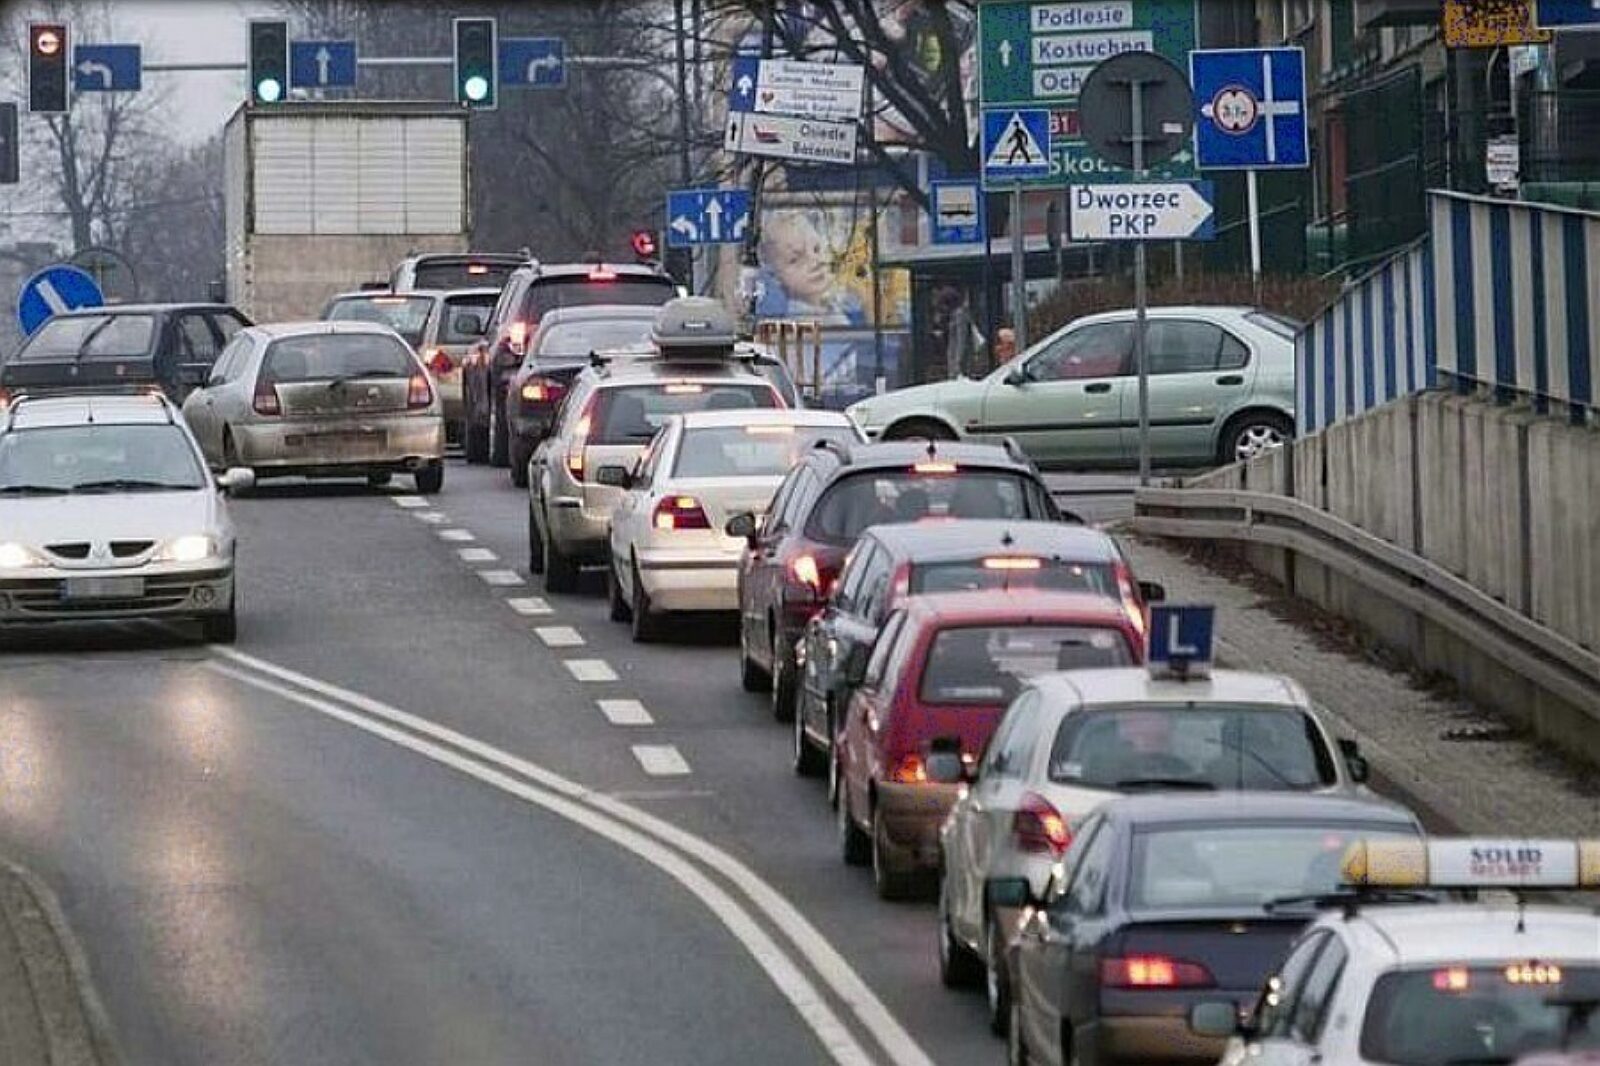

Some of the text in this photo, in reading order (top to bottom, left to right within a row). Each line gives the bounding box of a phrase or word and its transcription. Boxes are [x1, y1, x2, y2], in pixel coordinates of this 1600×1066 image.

[1038, 7, 1123, 26] Podlesie
[1041, 72, 1082, 91] Och
[1078, 188, 1180, 210] Dworzec
[1109, 213, 1157, 235] PKP
[1168, 614, 1199, 654] L
[1470, 847, 1542, 864] SOLID
